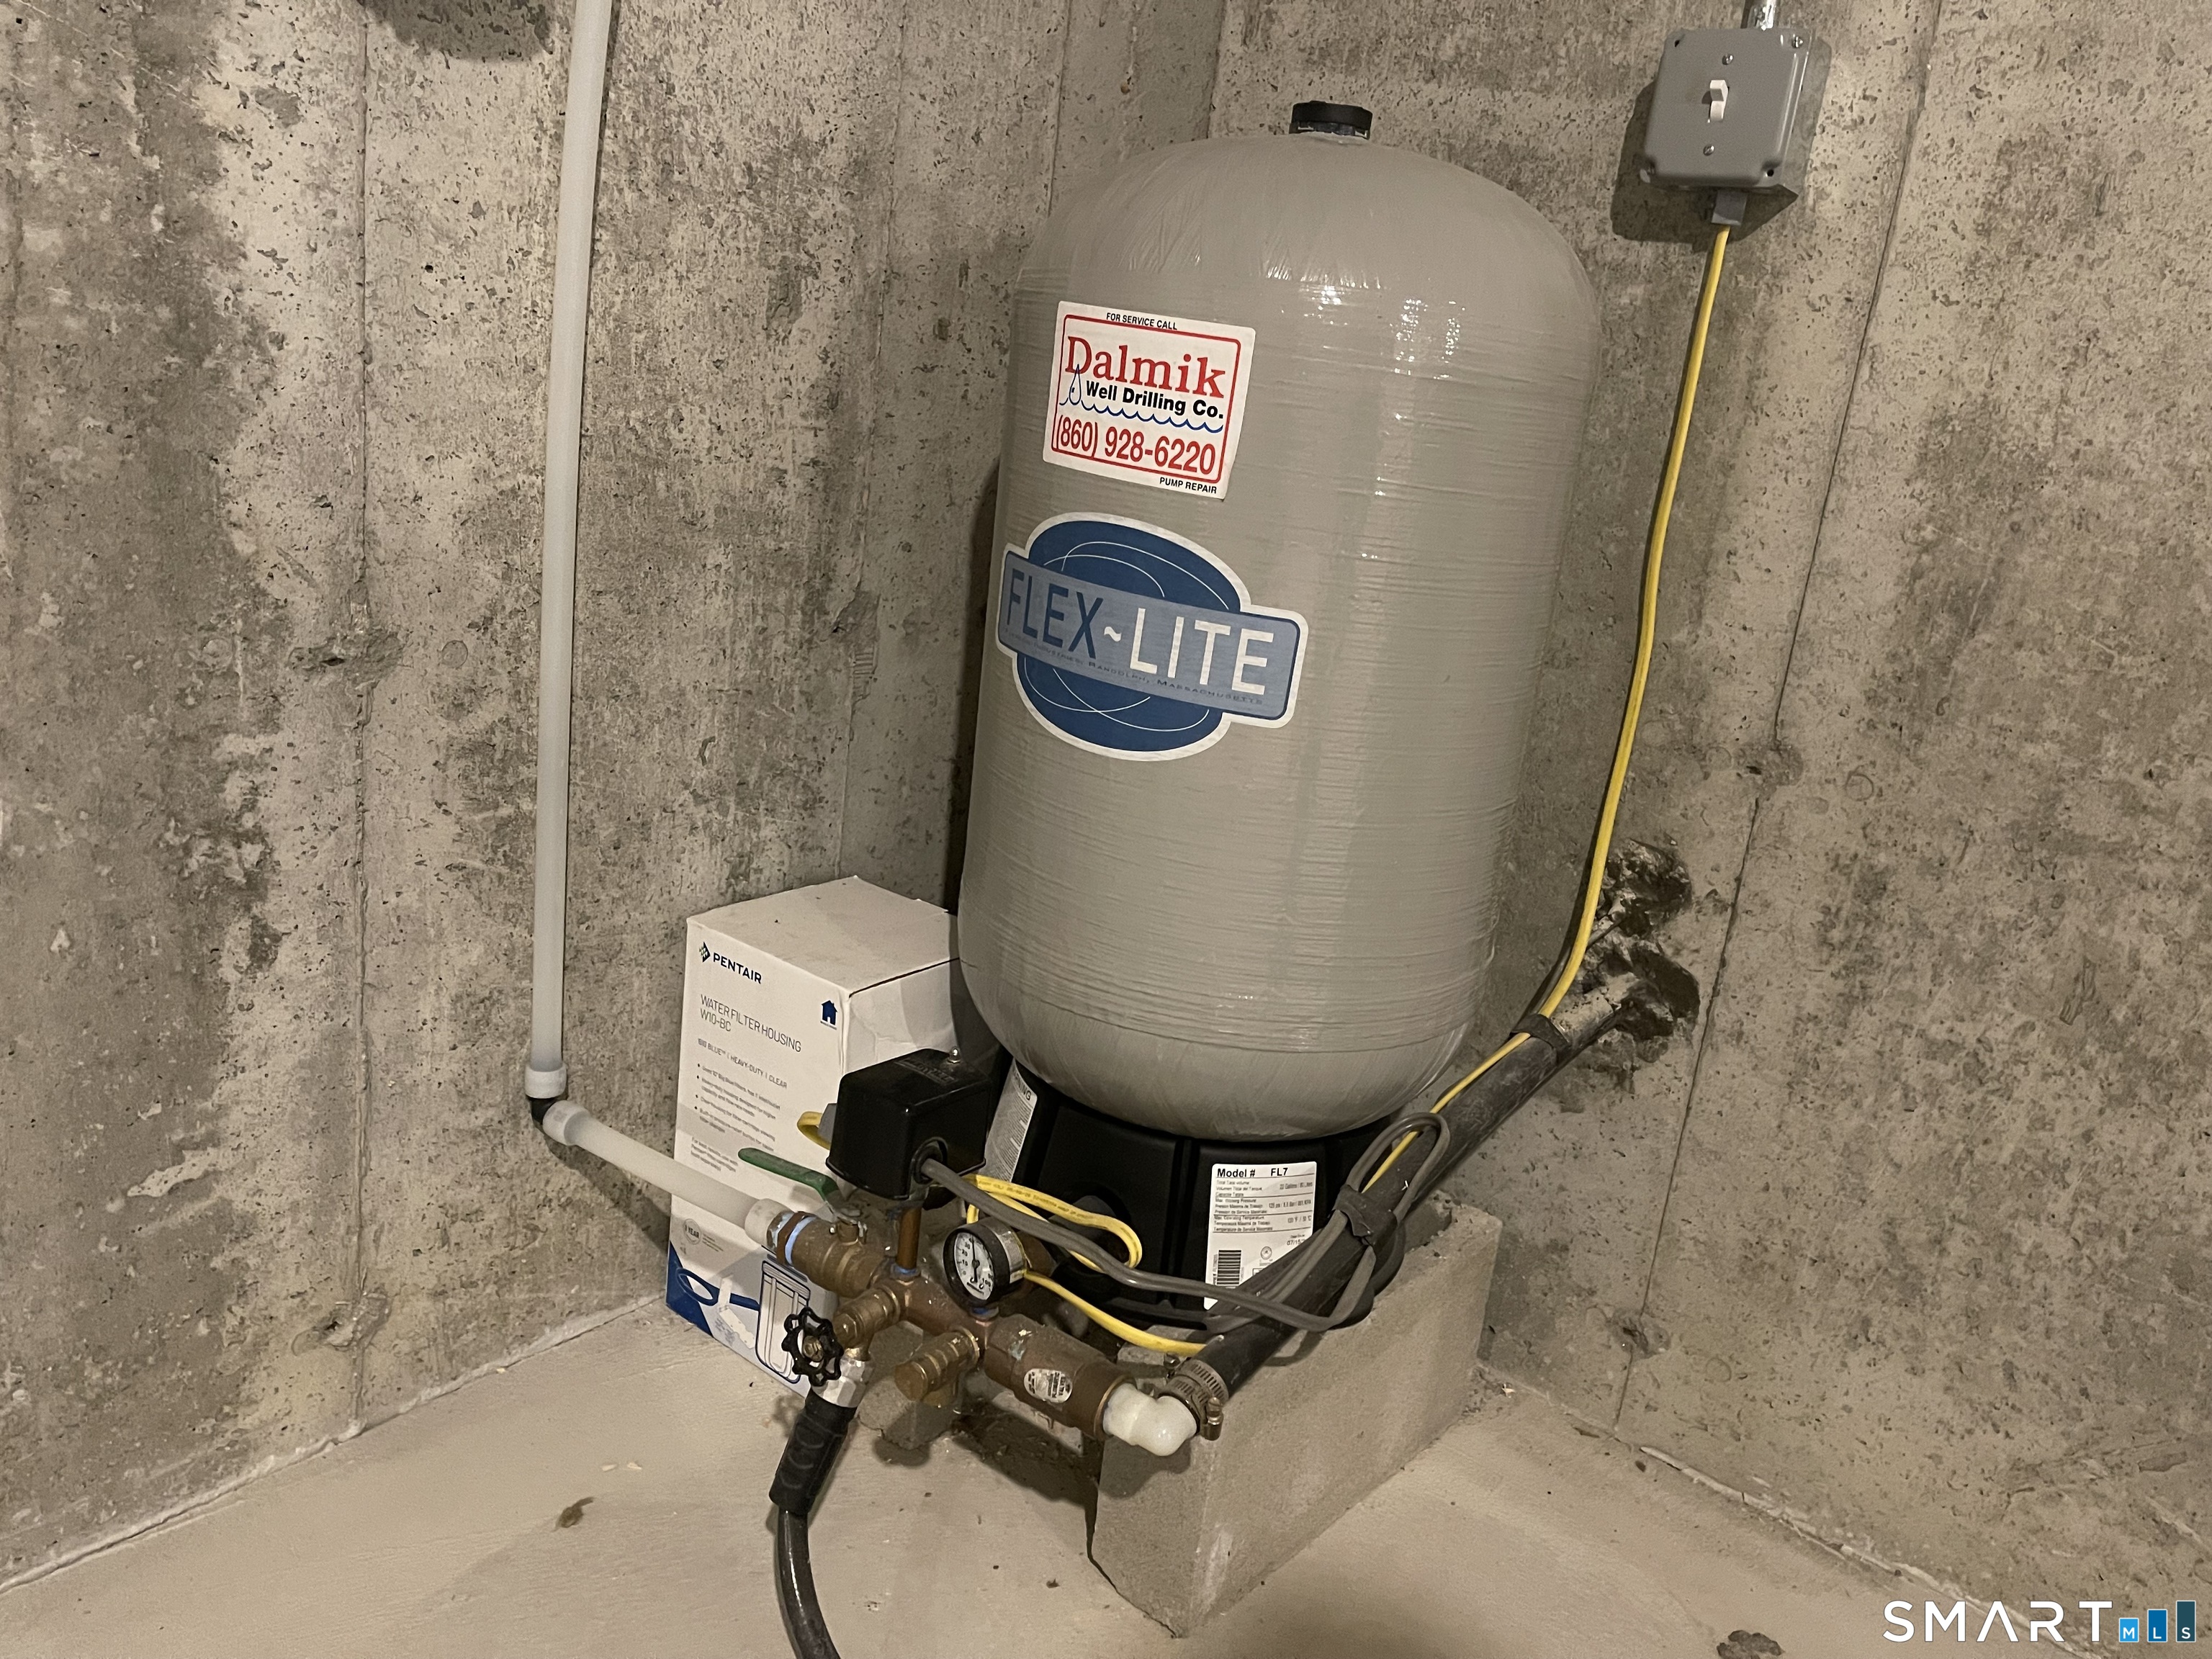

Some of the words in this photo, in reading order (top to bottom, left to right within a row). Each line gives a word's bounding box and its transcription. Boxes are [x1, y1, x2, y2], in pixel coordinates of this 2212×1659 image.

[1106, 313, 1120, 323] FOR
[1122, 315, 1155, 328] SERVICE
[1156, 320, 1177, 331] CALL
[1065, 336, 1226, 398] Dalmik
[1086, 380, 1117, 401] Well
[1123, 387, 1186, 416] Drilling
[1193, 400, 1223, 419] Co.
[1056, 415, 1098, 458] (860)
[1105, 426, 1216, 475] 928-6220
[1159, 477, 1183, 488] PUMP
[1185, 482, 1217, 494] REPAIR
[714, 952, 762, 984] PENTAIR
[701, 1008, 732, 1032] W10-BC
[701, 994, 729, 1020] WATER
[731, 1009, 760, 1033] FILTER
[762, 1025, 801, 1053] HOUSING
[731, 1056, 763, 1076] HEAVY-DUTY
[768, 1074, 787, 1089] CLEAR
[1217, 1168, 1247, 1178] Model
[1249, 1169, 1256, 1177] #
[1270, 1167, 1289, 1177] FL7
[688, 1226, 699, 1239] YEAR
